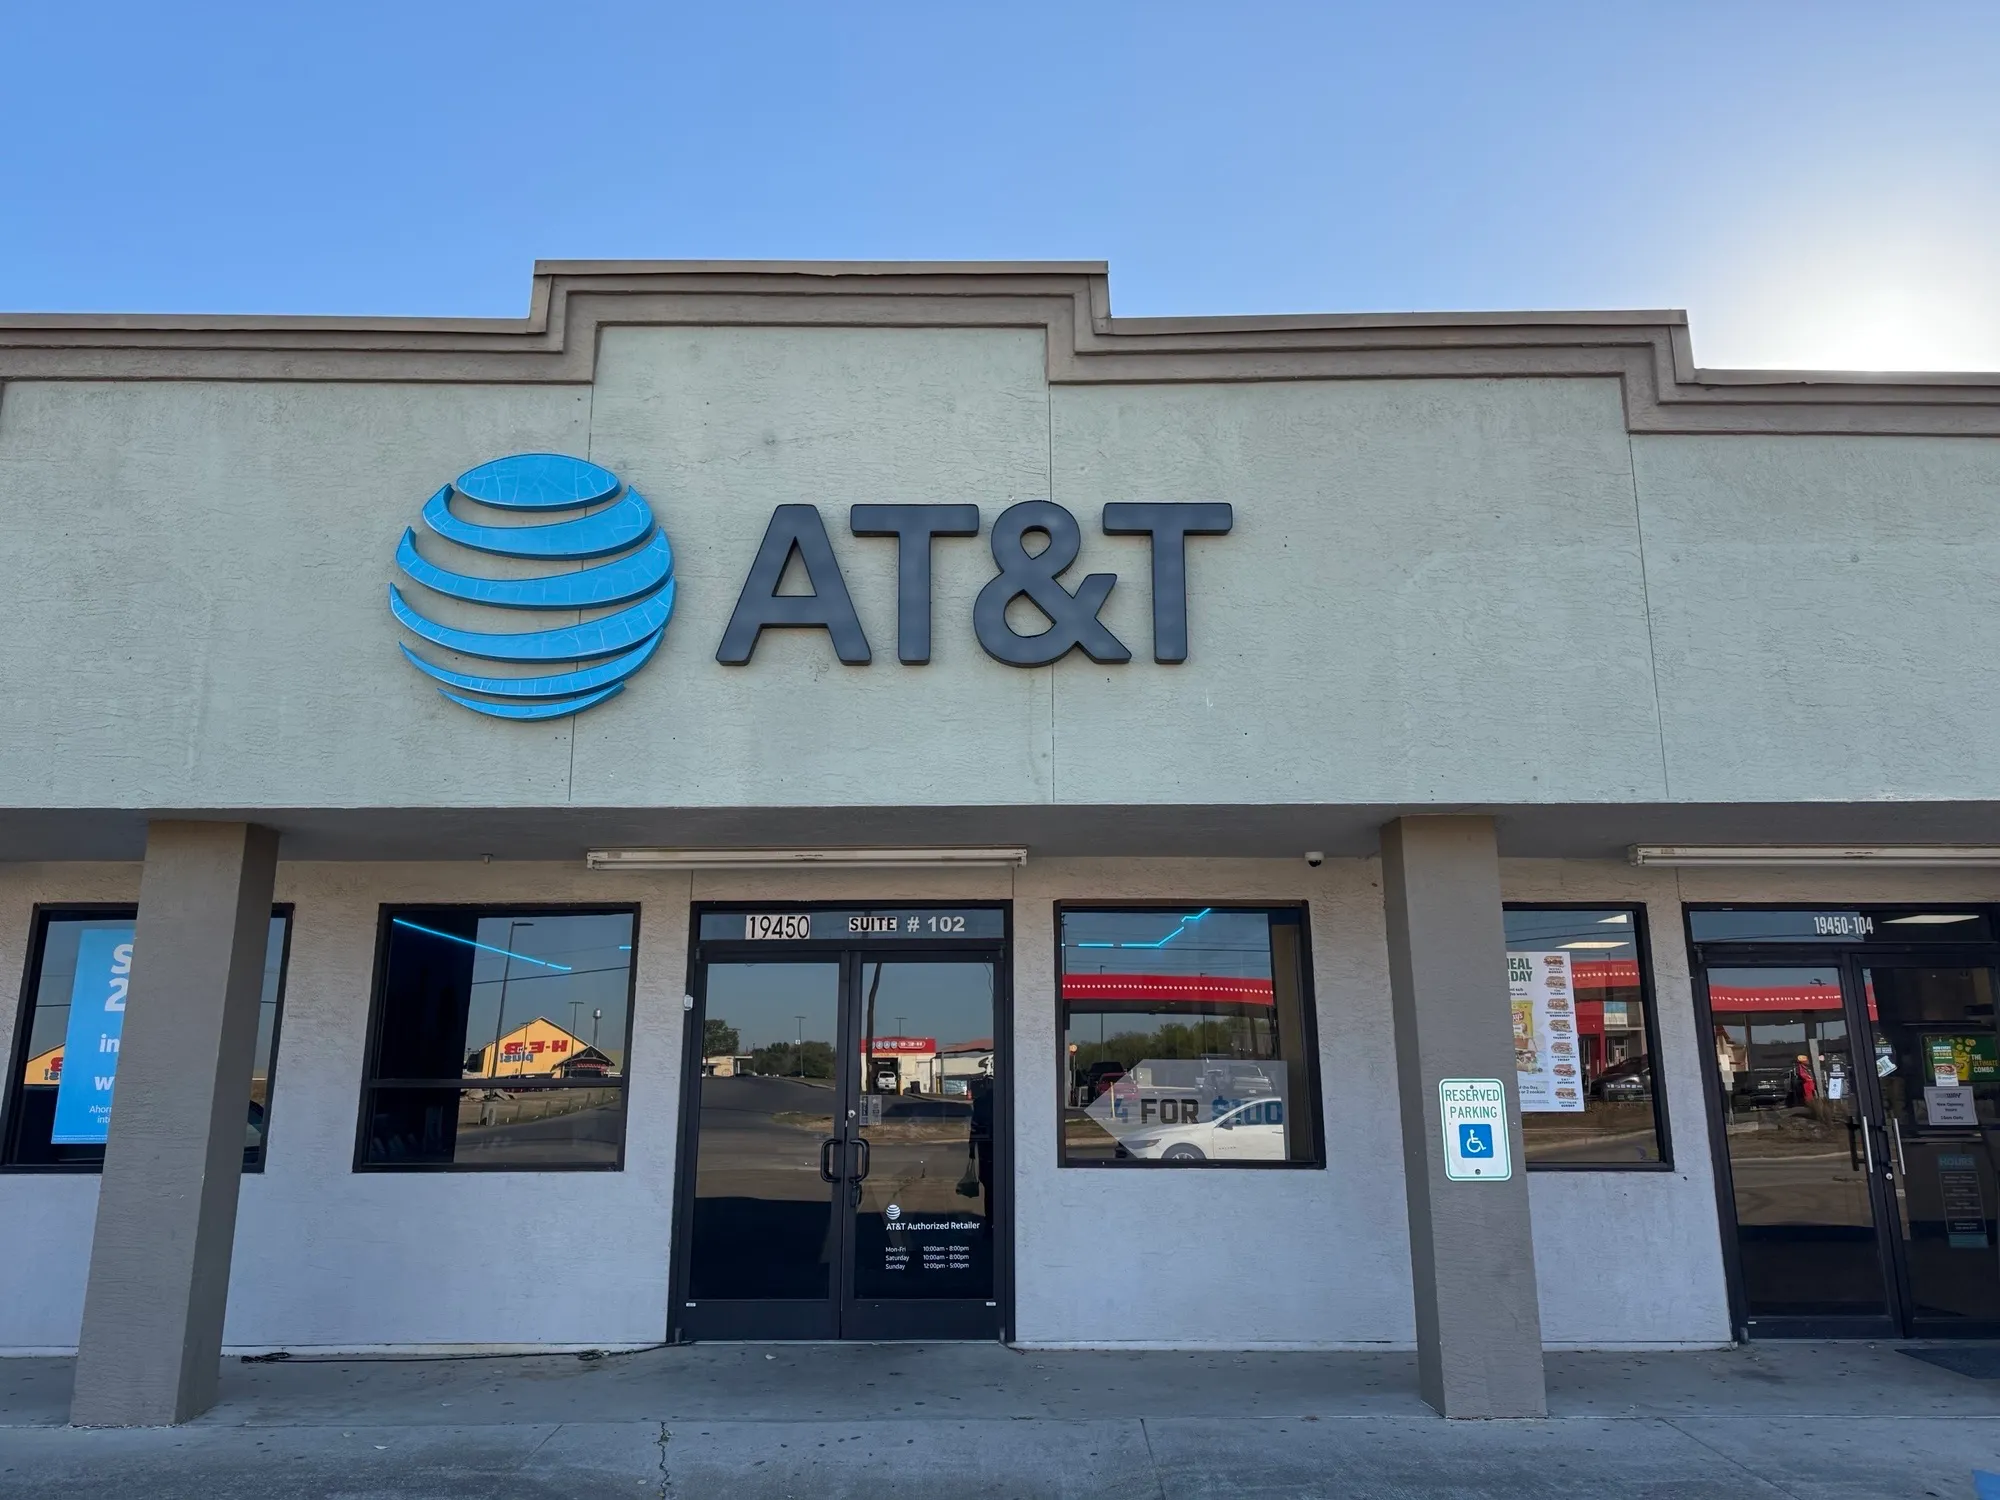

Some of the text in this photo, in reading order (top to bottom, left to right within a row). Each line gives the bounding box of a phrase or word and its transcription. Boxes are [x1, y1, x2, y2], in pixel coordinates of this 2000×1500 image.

[717, 500, 1233, 667] AT&T
[749, 915, 810, 939] 19450
[849, 916, 965, 932] SUITE # 102
[1813, 916, 1874, 935] 19450-104
[110, 943, 133, 975] S
[104, 977, 129, 1012] 2
[1445, 1089, 1500, 1102] RESERVED
[1140, 1098, 1199, 1124] FOR
[1212, 1095, 1284, 1125] $100
[1450, 1106, 1498, 1119] PARKING
[886, 1221, 980, 1231] AT&T Authorized Retailer
[885, 1254, 910, 1262] Saturday
[885, 1263, 906, 1271] Sunday
